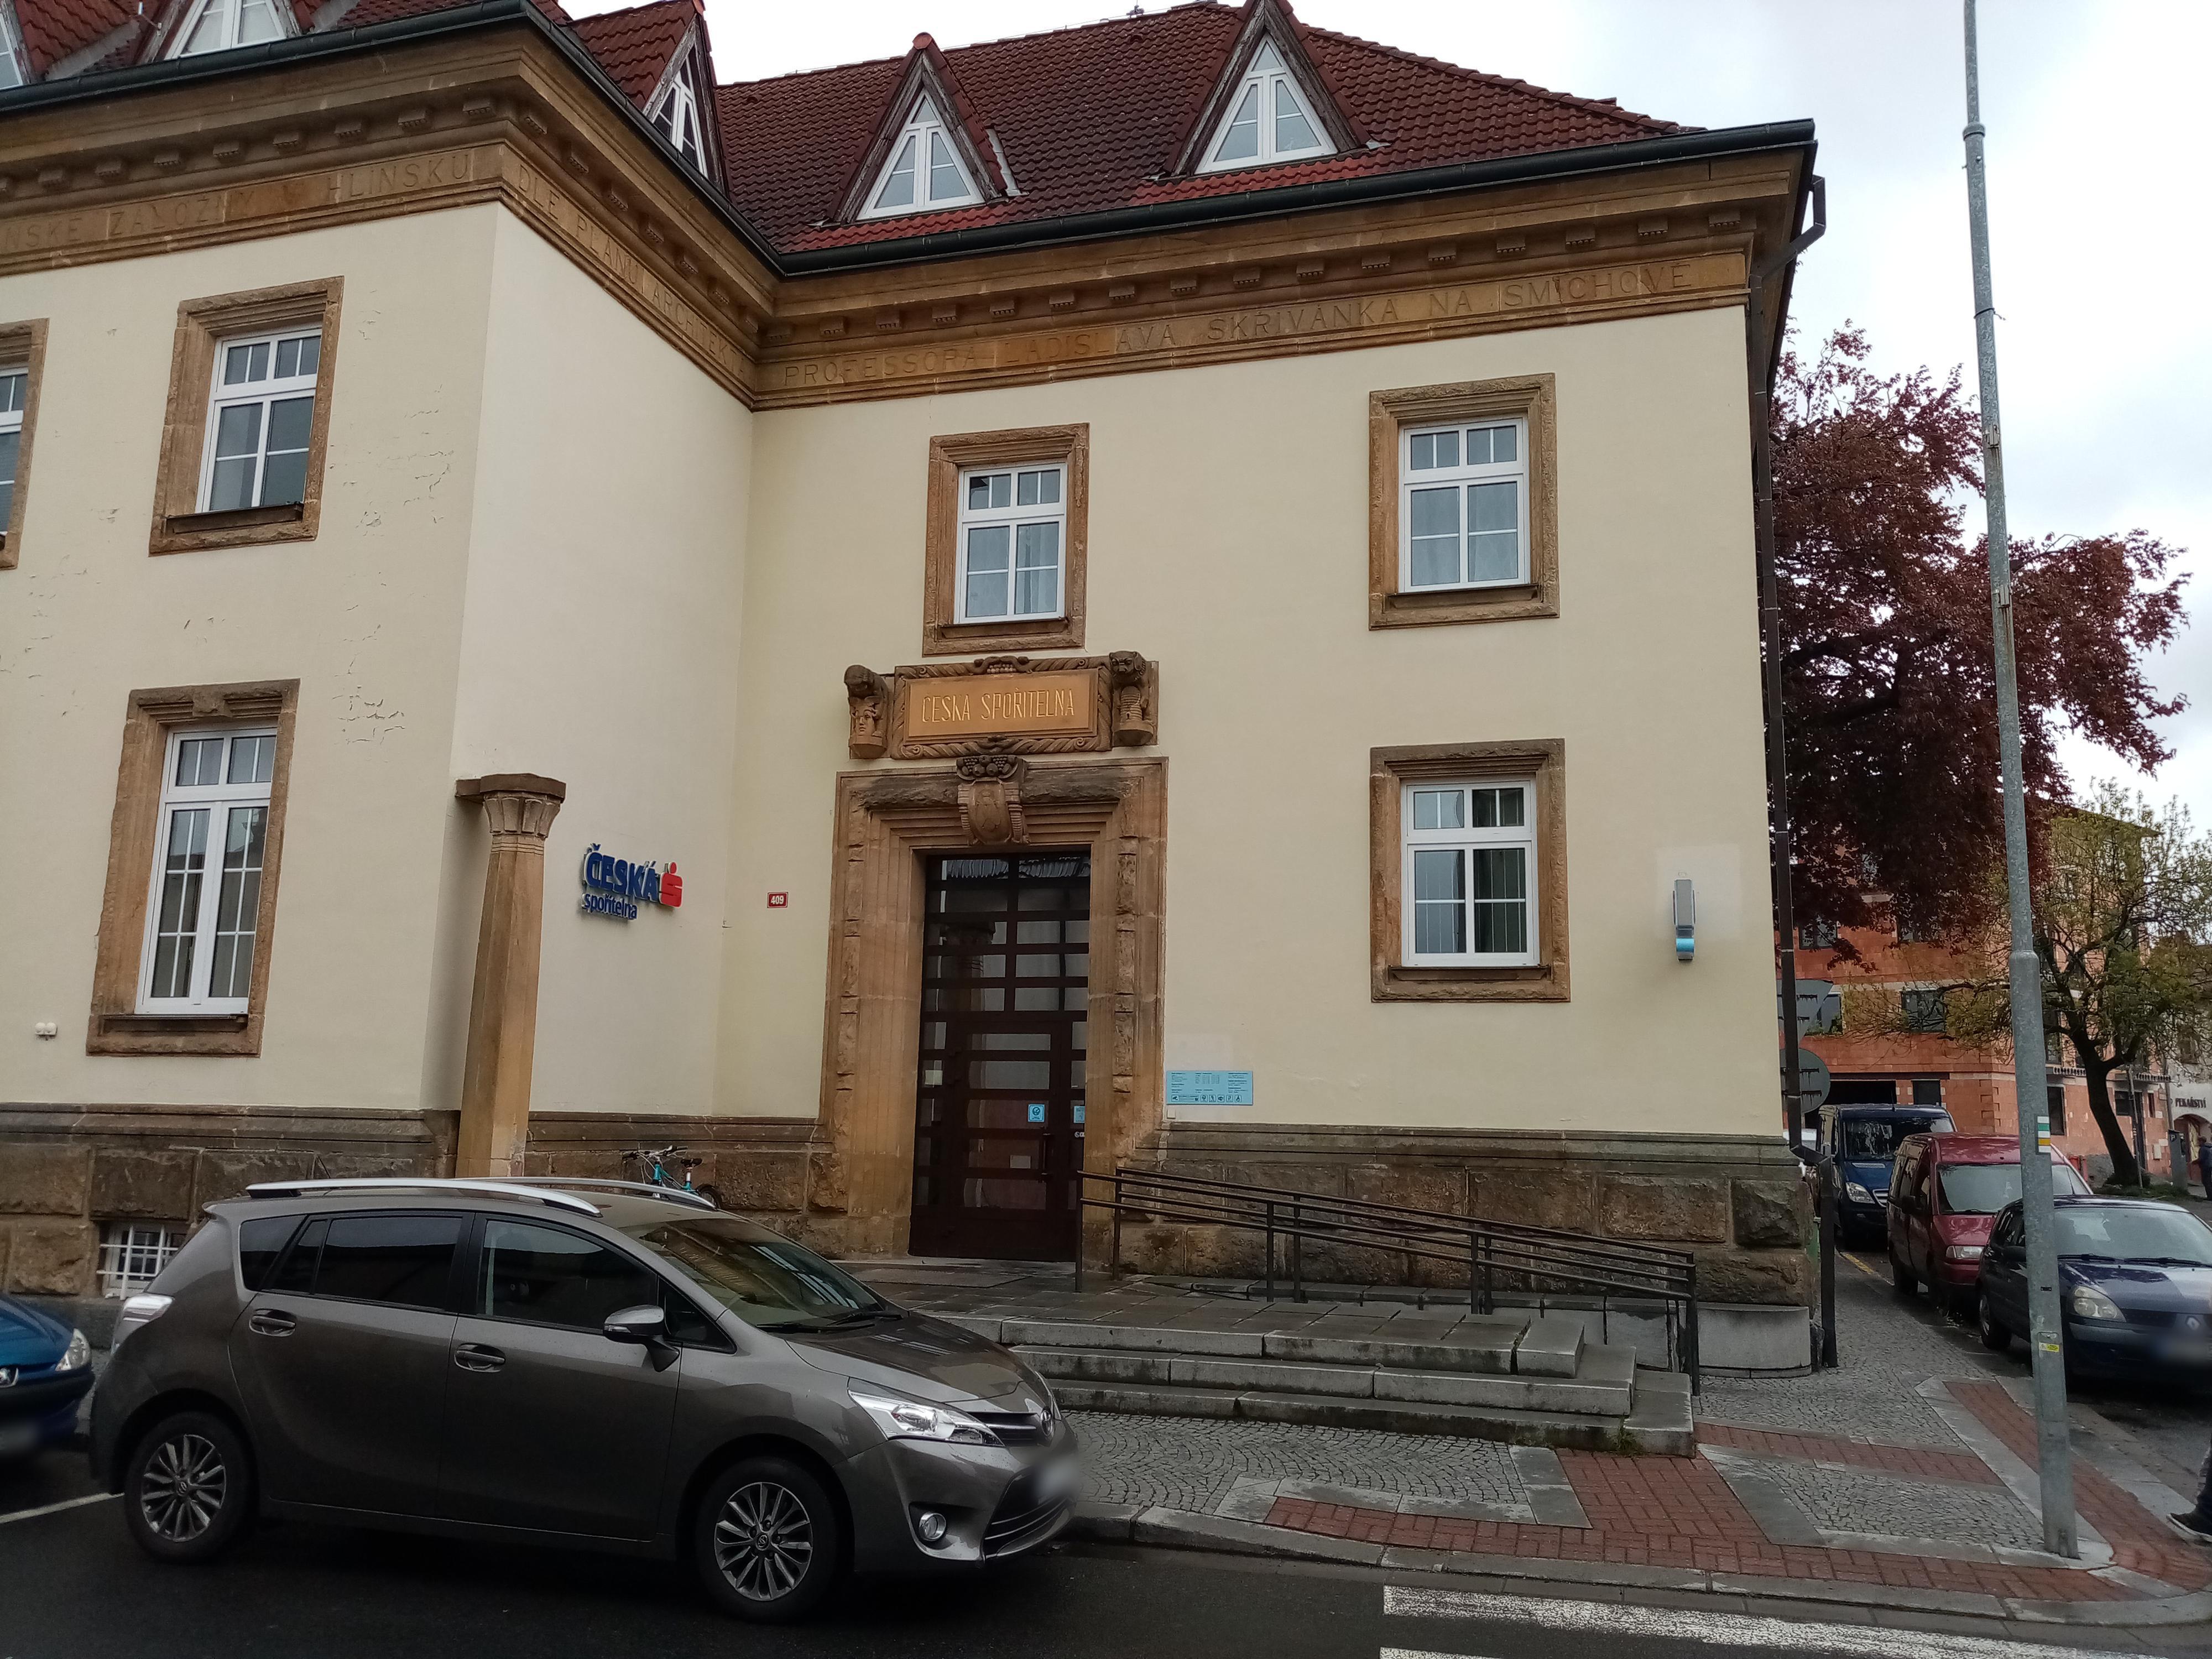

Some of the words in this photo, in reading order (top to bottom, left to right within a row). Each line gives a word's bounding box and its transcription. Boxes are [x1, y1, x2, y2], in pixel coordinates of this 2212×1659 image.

[328, 154, 468, 201] HLINSKU
[519, 164, 560, 220] DLE
[650, 283, 748, 379] ARCHITEKTA
[784, 347, 978, 386] PROFESSORA
[1004, 324, 1176, 363] LADISLAVA
[1428, 290, 1473, 316] NA
[585, 843, 659, 902] ČESKÁ
[582, 893, 638, 920] spořitelna
[771, 895, 784, 905] 409
